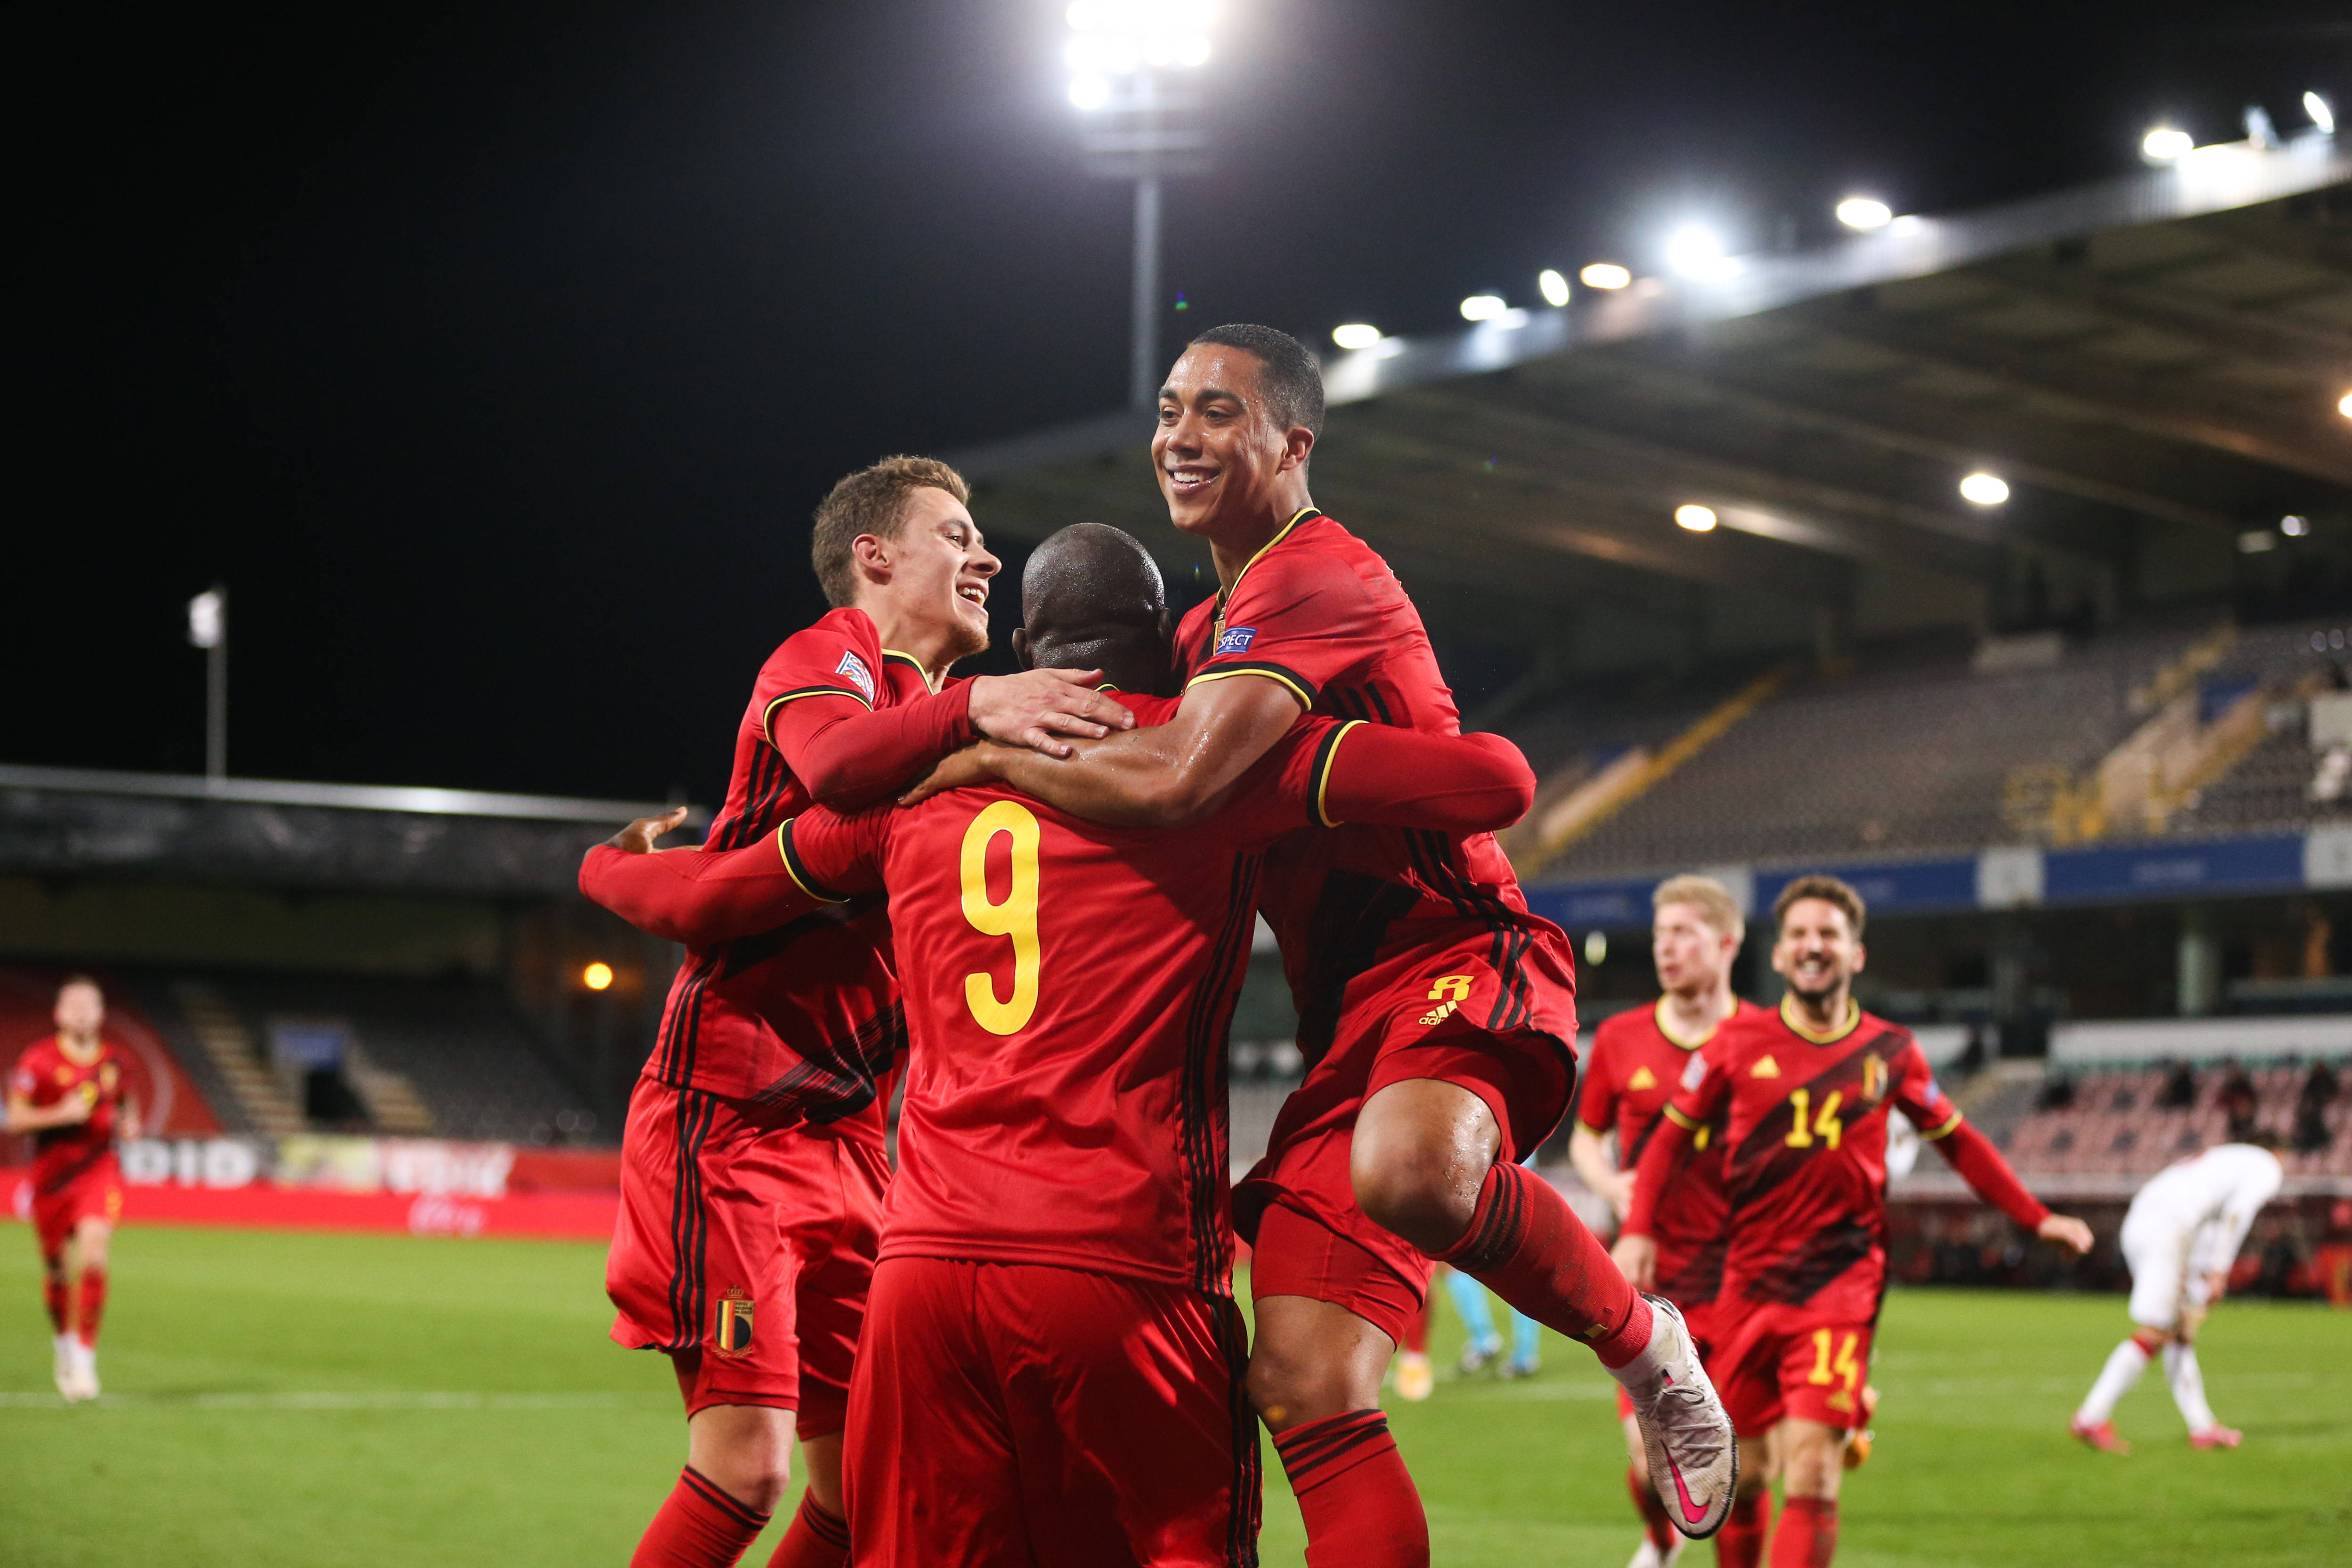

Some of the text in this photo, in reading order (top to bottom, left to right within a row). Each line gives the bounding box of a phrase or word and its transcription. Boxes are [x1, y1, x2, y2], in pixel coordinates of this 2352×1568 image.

[1219, 634, 1253, 649] SPECT
[960, 800, 1041, 1035] 9
[1784, 1089, 1843, 1150] 14
[1807, 1327, 1859, 1390] 14
